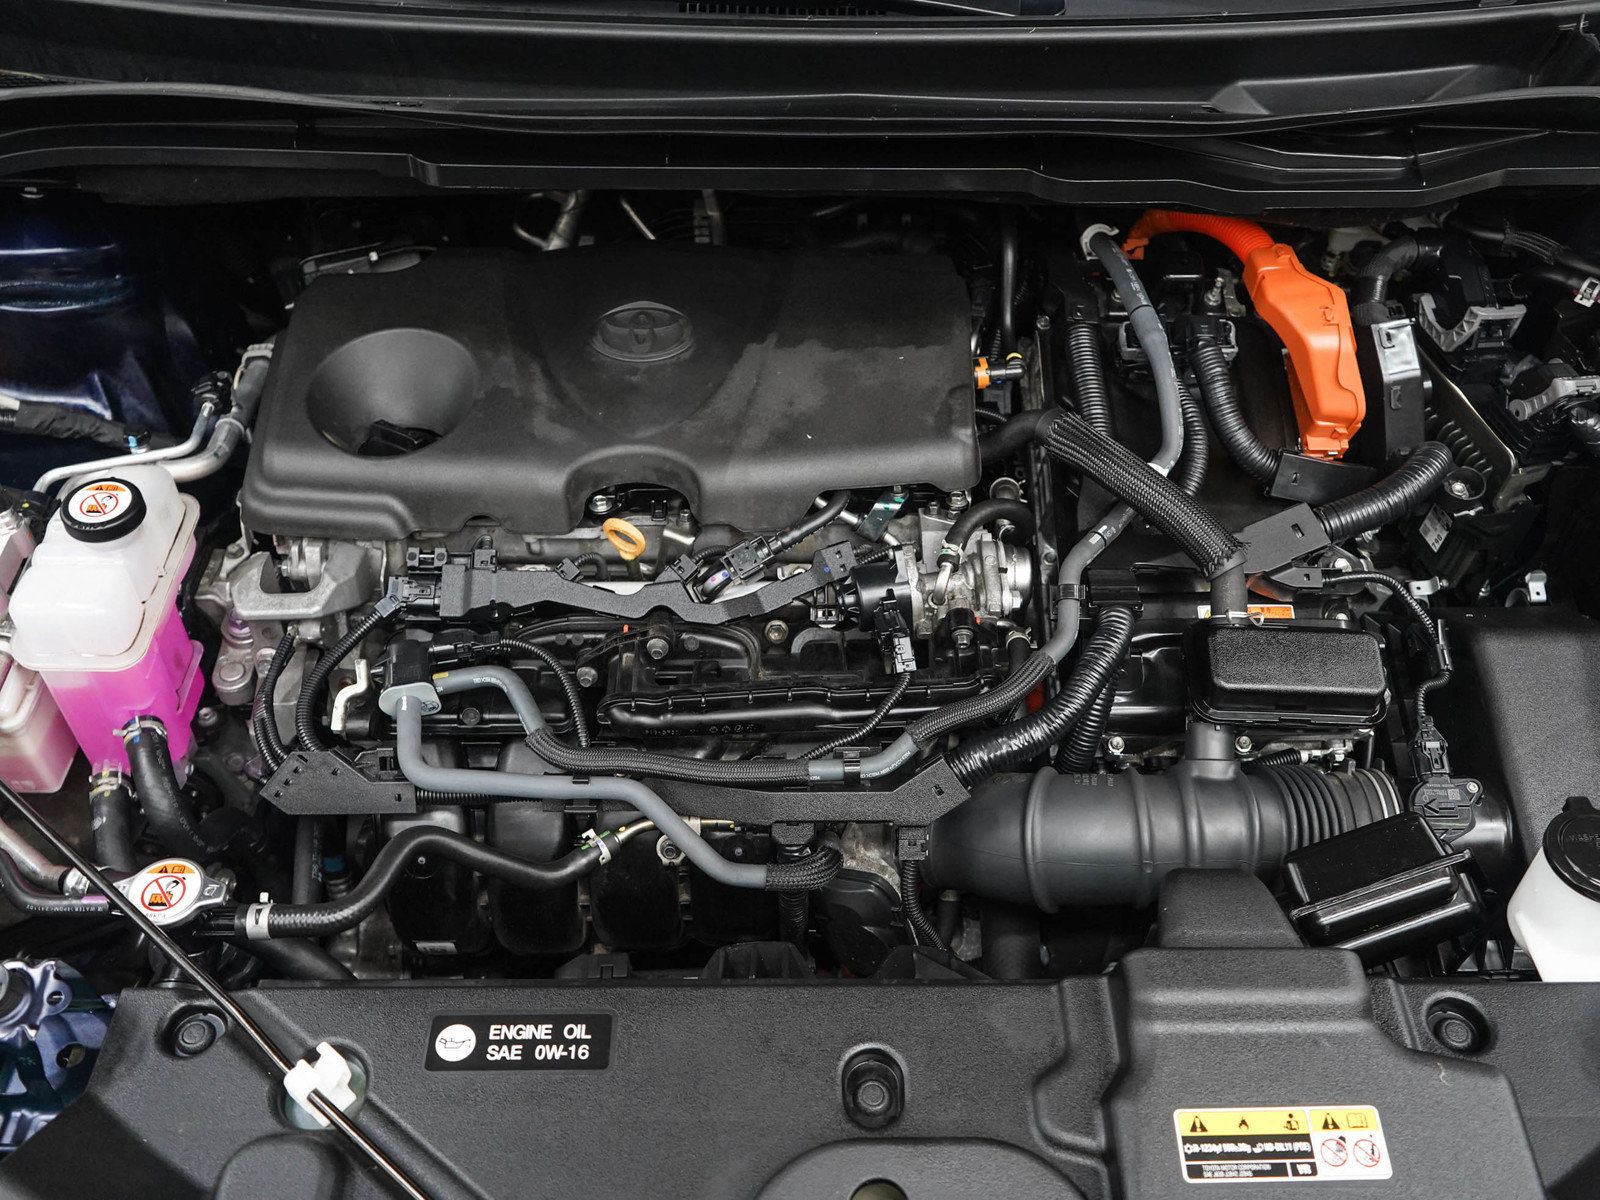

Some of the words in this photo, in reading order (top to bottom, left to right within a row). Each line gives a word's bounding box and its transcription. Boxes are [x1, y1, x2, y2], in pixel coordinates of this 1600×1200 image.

[489, 1024, 553, 1040] ENGINE
[563, 1024, 592, 1039] OIL
[486, 1045, 523, 1060] SAE
[534, 1045, 590, 1060] 0W-16
